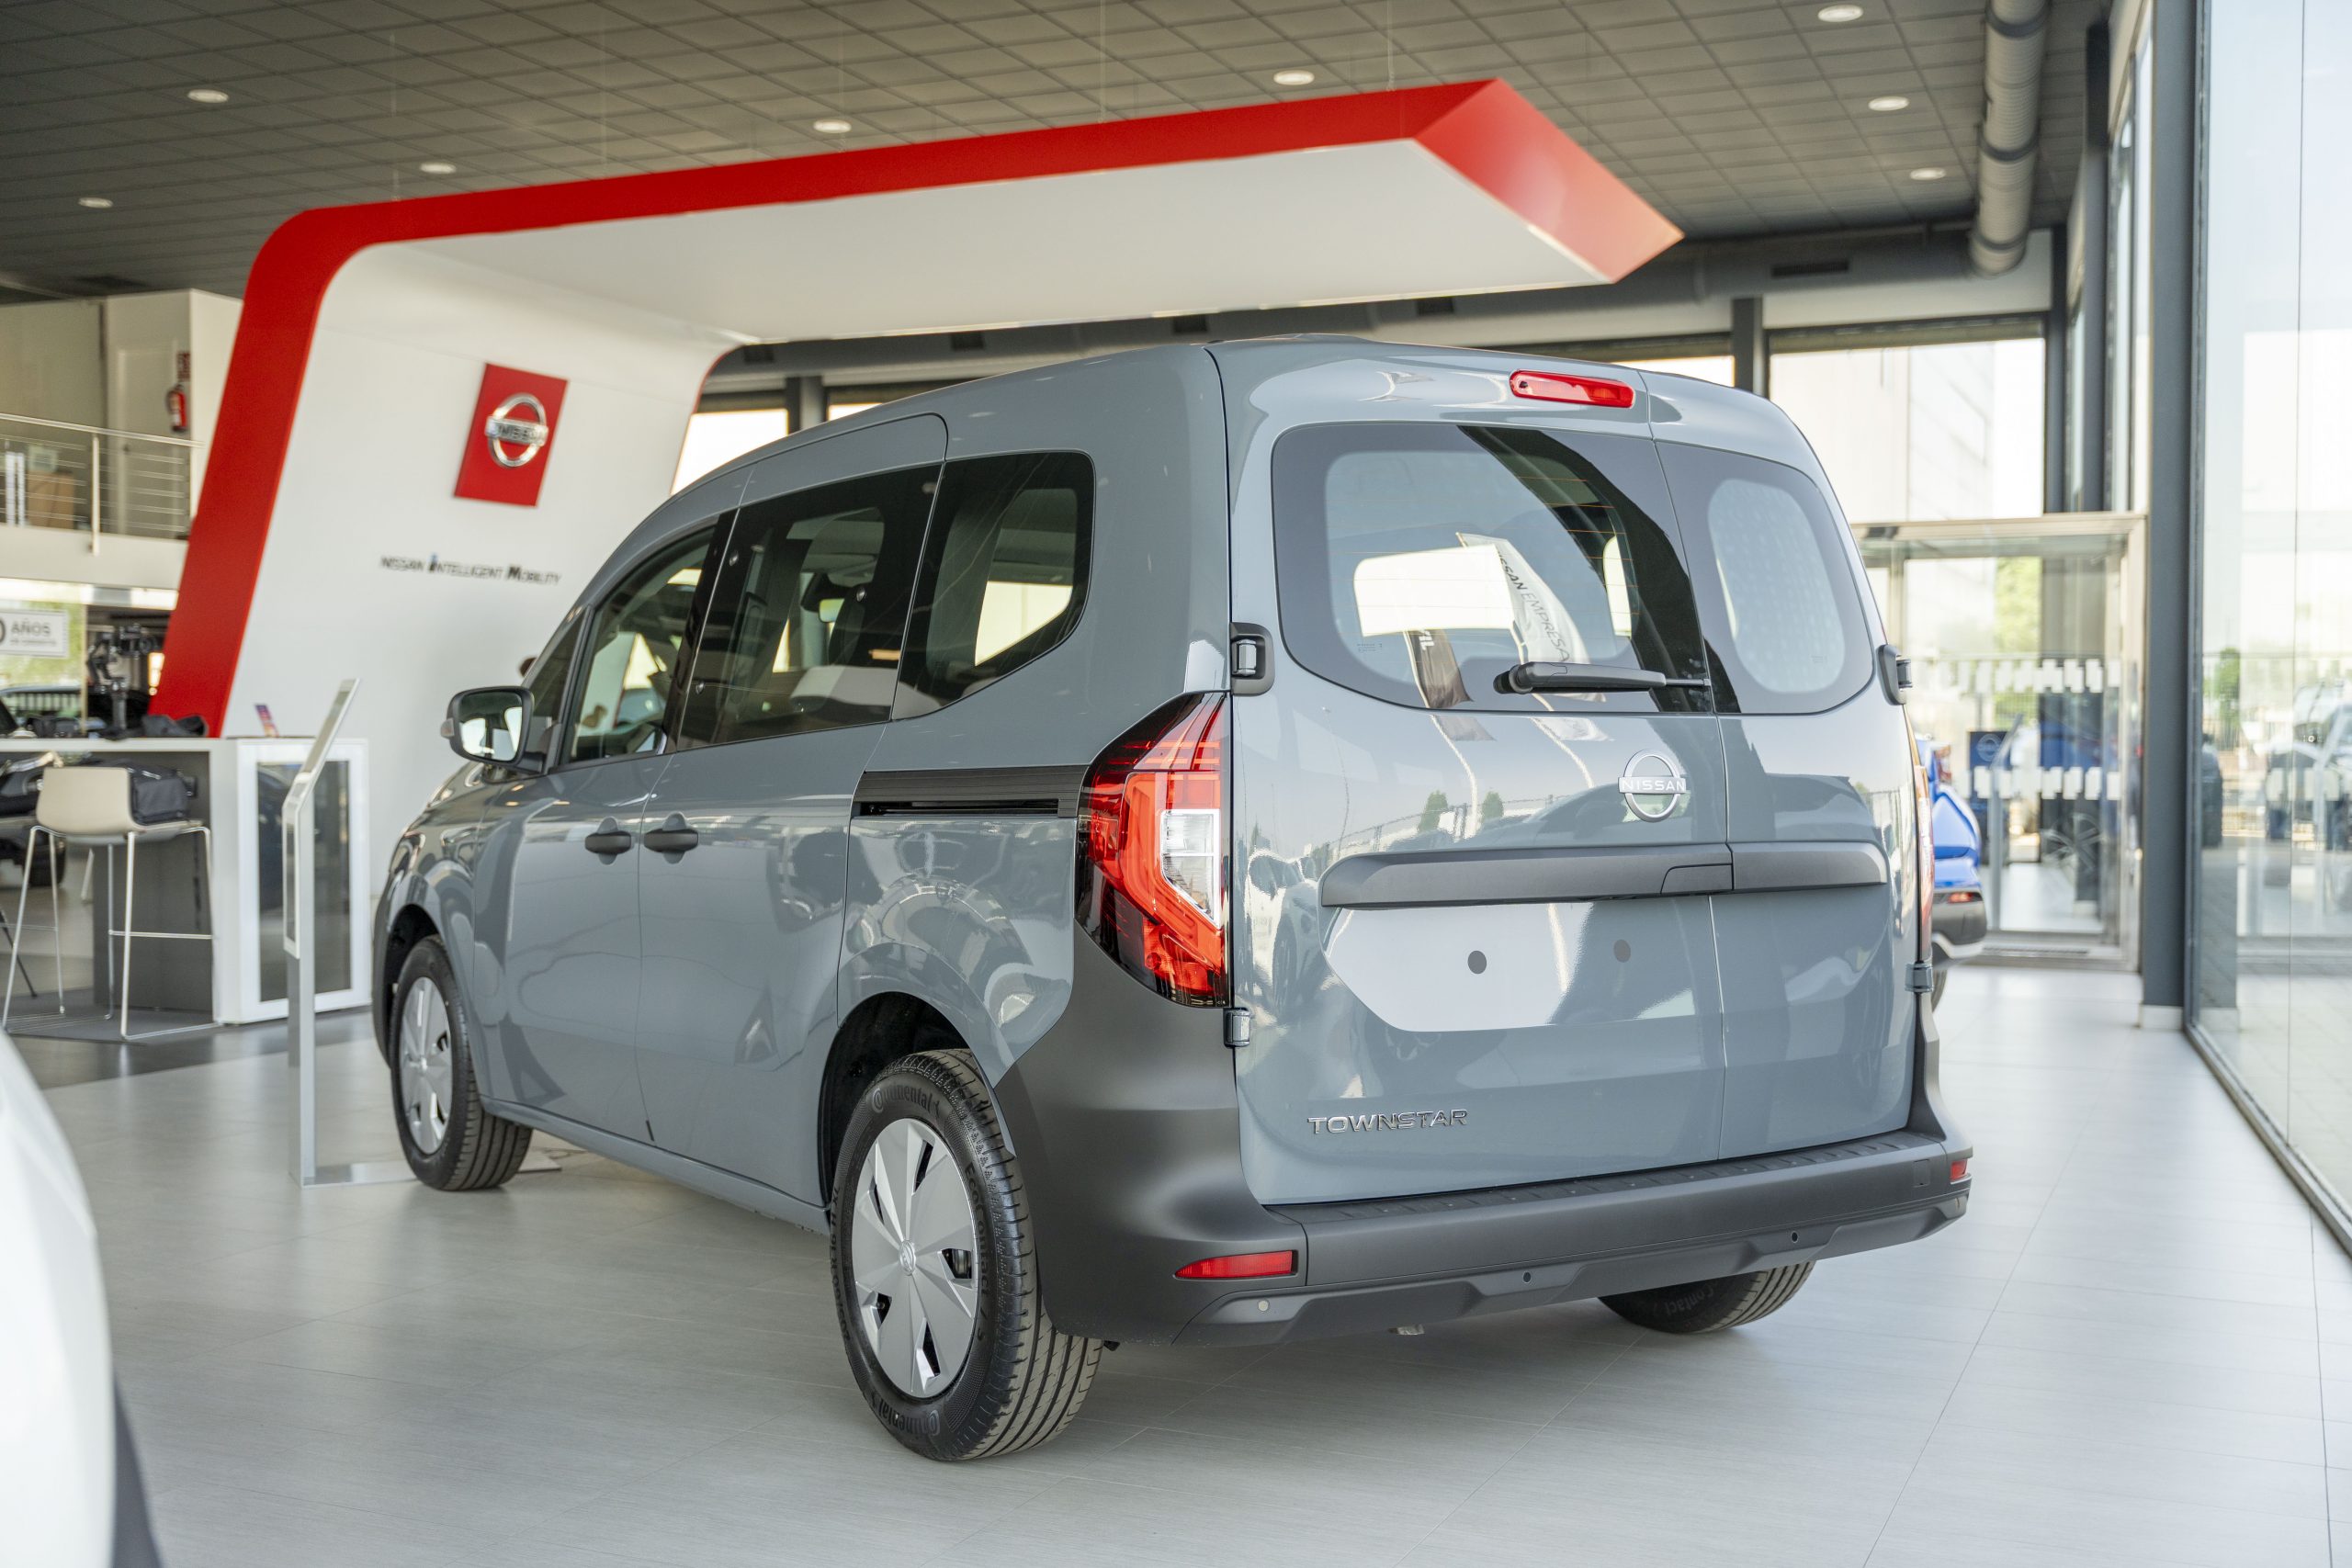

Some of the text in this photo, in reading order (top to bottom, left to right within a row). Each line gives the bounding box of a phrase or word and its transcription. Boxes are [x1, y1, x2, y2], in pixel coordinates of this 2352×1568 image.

[381, 555, 424, 571] NISSAN
[507, 564, 561, 585] MOBILITY
[1622, 779, 1685, 792] NISSAN
[872, 1082, 933, 1113] Continental
[1307, 1109, 1468, 1134] TOWNSTAR
[1665, 1285, 1714, 1316] Contact
